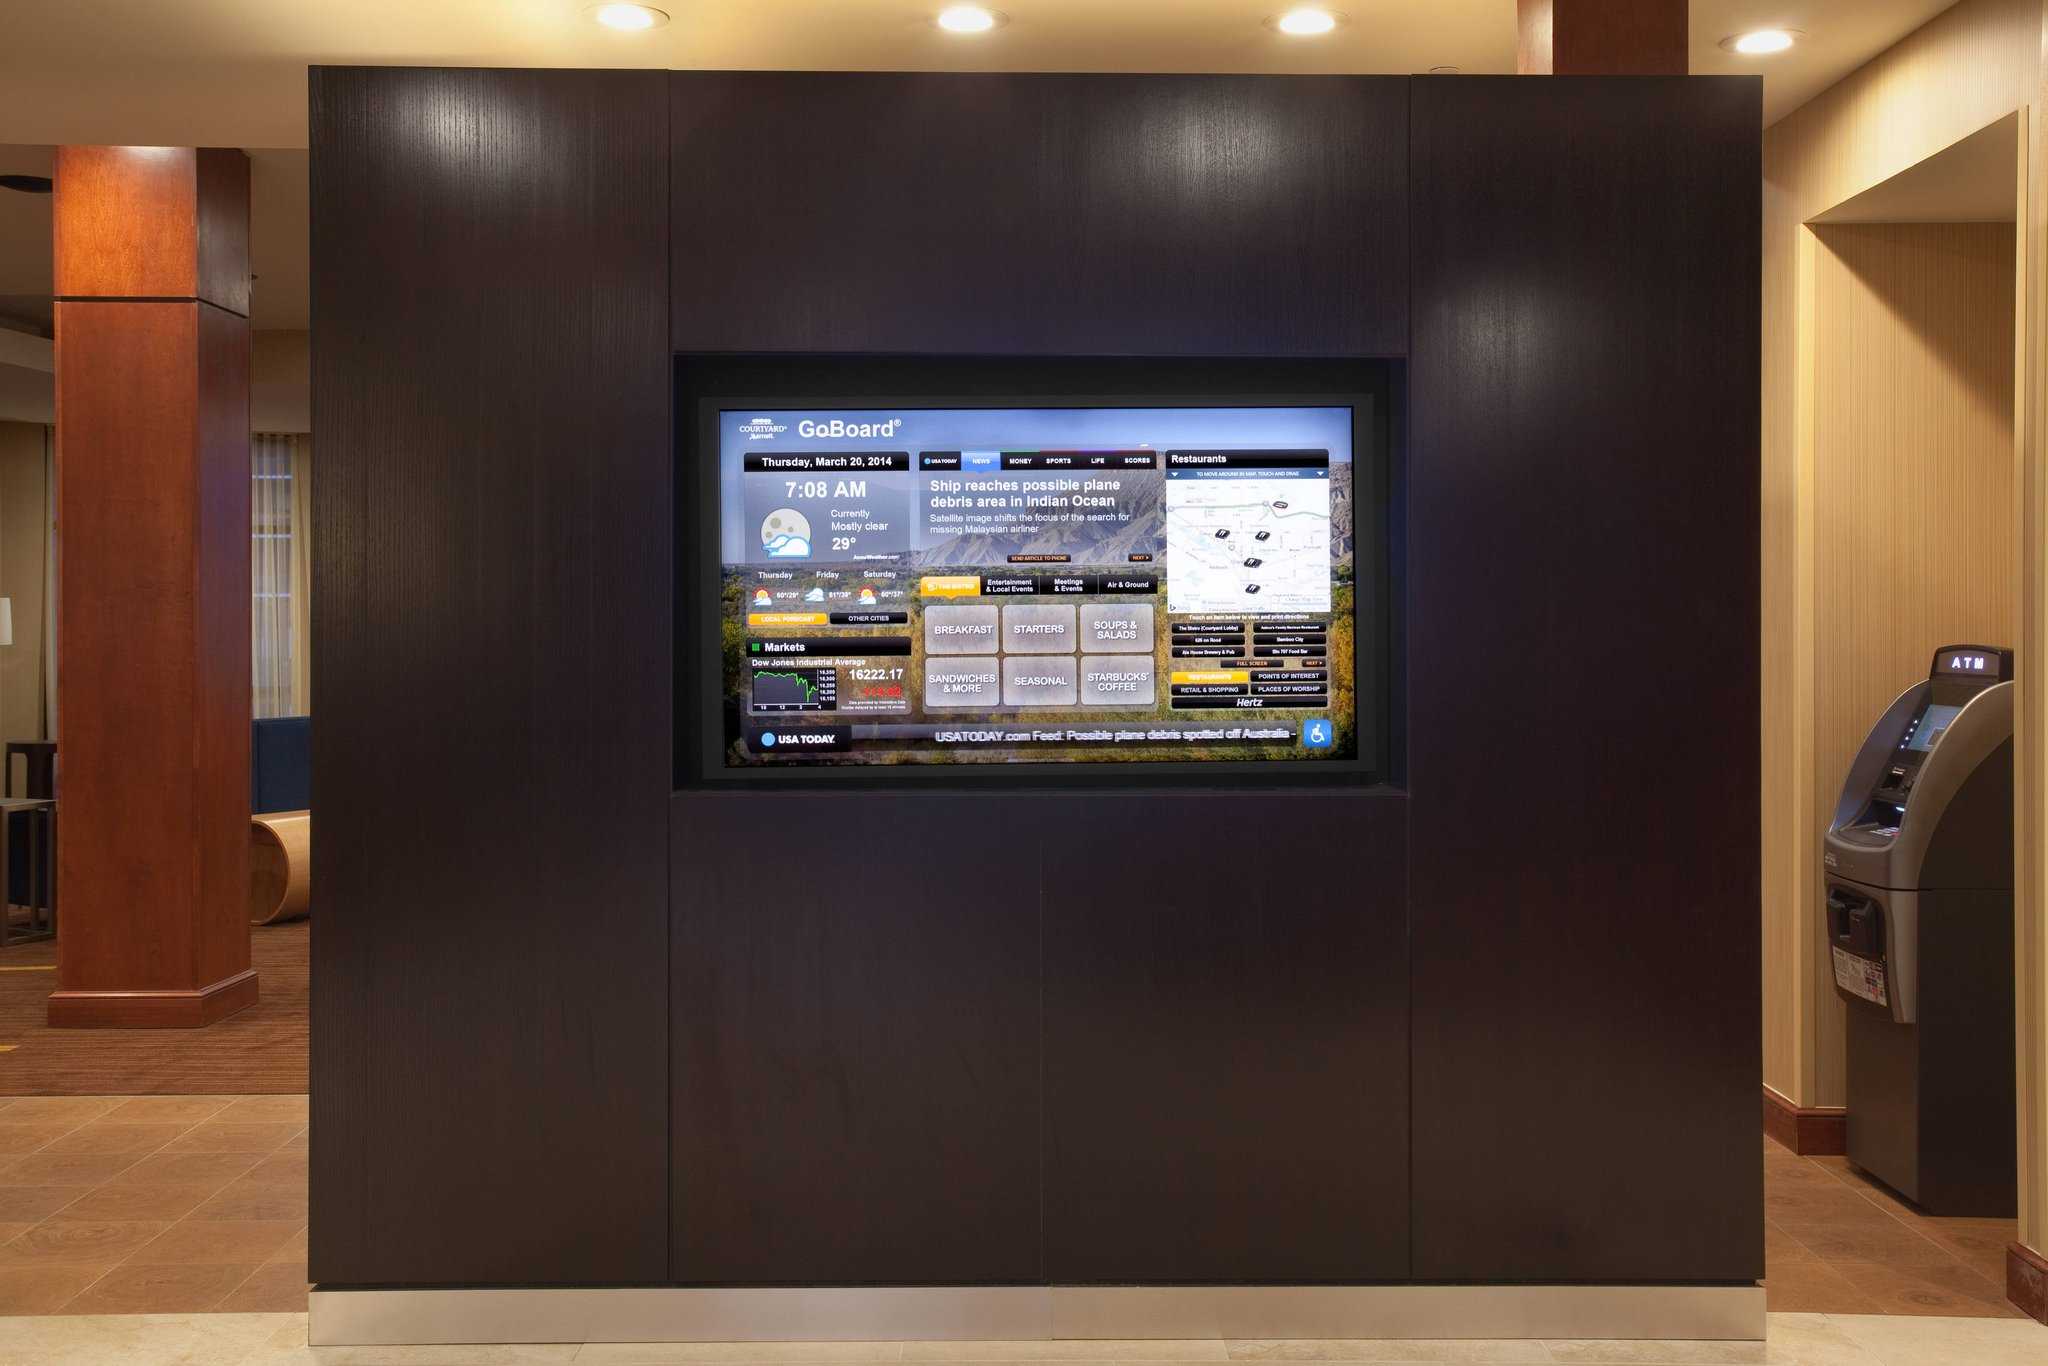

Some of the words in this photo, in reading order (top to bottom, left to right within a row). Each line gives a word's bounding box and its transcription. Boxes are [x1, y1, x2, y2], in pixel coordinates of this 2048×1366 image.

[762, 457, 813, 467] Thursday,
[815, 457, 847, 466] March
[851, 457, 865, 467] 20,
[868, 457, 892, 466] 2014
[1171, 455, 1227, 464] Restaurants
[785, 481, 827, 498] 7:08
[833, 481, 866, 498] AM
[930, 480, 961, 494] Ship
[966, 480, 1018, 491] reaches
[1023, 480, 1080, 493] possible
[1084, 480, 1120, 492] plane
[930, 496, 972, 508] debris
[977, 498, 1006, 508] area
[1011, 496, 1022, 507] in
[1027, 496, 1068, 507] Indian
[1072, 496, 1115, 507] Ocean
[830, 509, 870, 519] Currently
[930, 514, 964, 522] Satellite
[966, 514, 992, 524] image
[994, 513, 1016, 522] shifts
[1020, 513, 1033, 522] the
[1034, 513, 1058, 522] focus
[1061, 513, 1069, 522] of
[1071, 513, 1084, 522] the
[1086, 513, 1116, 522] search
[1118, 513, 1130, 521] for
[831, 522, 862, 532] Mostly
[865, 522, 888, 531] clear
[930, 526, 962, 536] missing
[965, 525, 1008, 535] Malaysian
[1010, 525, 1039, 534] airliner
[832, 537, 856, 550] 29°
[758, 571, 793, 580] Thursday
[816, 571, 840, 580] Friday
[864, 570, 896, 579] Saturday
[988, 578, 1032, 586] Entertainment
[1054, 578, 1084, 586] Meetings
[934, 625, 993, 635] BREAKFAST
[1014, 624, 1065, 634] STARTERS
[1094, 621, 1128, 630] SOUPS
[1130, 621, 1137, 630] &
[1097, 630, 1137, 640] SALADS
[764, 643, 805, 652] Markets
[1952, 657, 1984, 669] ATM
[849, 669, 903, 680] 16222.17
[928, 674, 996, 684] SANDWICHES
[1014, 676, 1068, 686] SEASONAL
[944, 684, 951, 693] &
[952, 684, 982, 693] MORE
[1098, 682, 1137, 692] COFFEE
[1236, 698, 1263, 707] Hertz
[778, 735, 799, 744] USA
[935, 732, 1030, 742] USATODAY.com
[1032, 731, 1063, 741] Feed:
[1066, 730, 1113, 741] Possible
[1115, 730, 1145, 742] plane
[1148, 730, 1182, 740] debris
[1183, 729, 1224, 741] spotted
[1226, 729, 1242, 739] off
[1242, 728, 1289, 739] Australia
